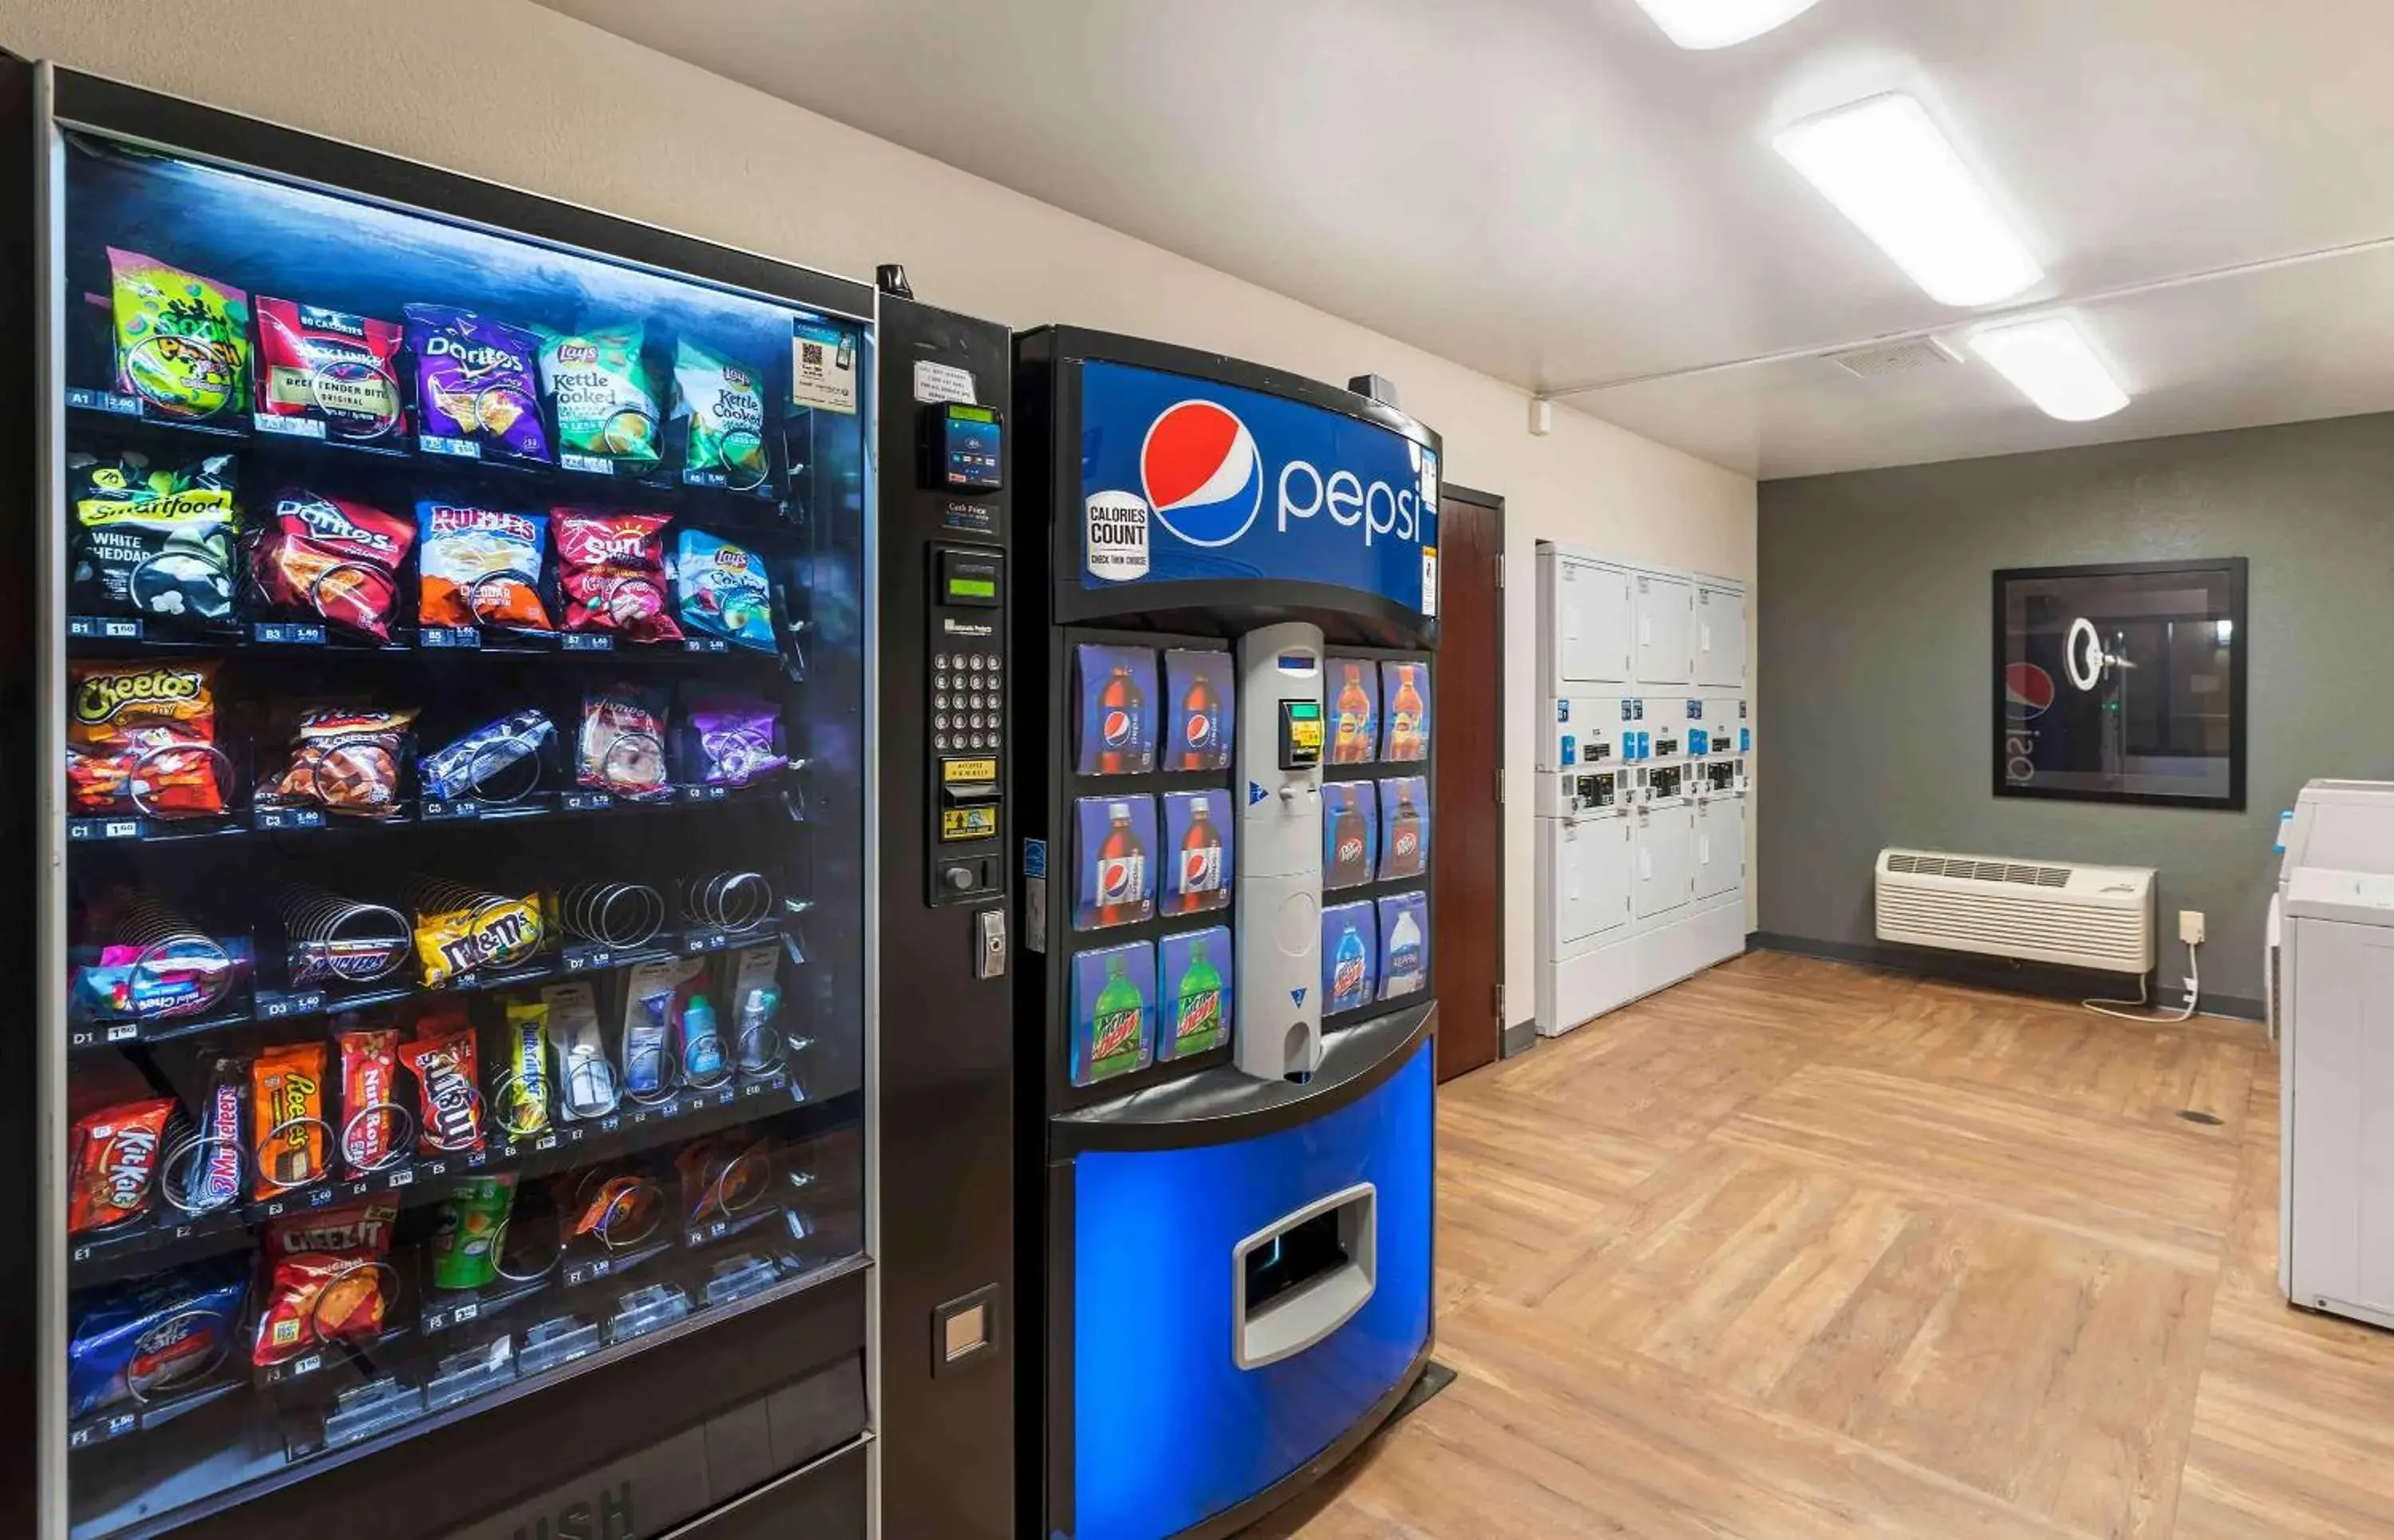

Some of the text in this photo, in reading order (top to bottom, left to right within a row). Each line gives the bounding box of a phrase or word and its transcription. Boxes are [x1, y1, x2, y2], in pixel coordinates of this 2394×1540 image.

[426, 336, 523, 373] Doritos
[552, 371, 608, 392] Kettle
[72, 395, 89, 405] A1
[558, 387, 615, 405] ooked
[719, 388, 758, 411] Kettle
[1278, 460, 1420, 546] pepsi
[1090, 506, 1145, 523] CALORIES
[276, 500, 389, 548] Doritos
[92, 531, 142, 549] WHITE
[1092, 523, 1145, 545] COUNT
[85, 546, 152, 563] HEDDA
[583, 537, 646, 565] Sun
[460, 584, 511, 598] CHDDAR
[710, 570, 766, 597] Cooed
[72, 623, 89, 634] B1
[266, 629, 281, 639] B3
[78, 668, 203, 720] Cheetos
[266, 815, 281, 826] C3
[72, 826, 88, 836] C1
[570, 959, 585, 969] D7
[269, 1004, 286, 1016] D3
[73, 1032, 93, 1044] D1
[285, 1071, 316, 1150] Reee's
[214, 1084, 239, 1175] Muketeers
[354, 1183, 367, 1194] E4
[269, 1203, 283, 1215] E3
[176, 1226, 192, 1238] E2
[74, 1247, 90, 1261] E1
[72, 1429, 89, 1446] F1
